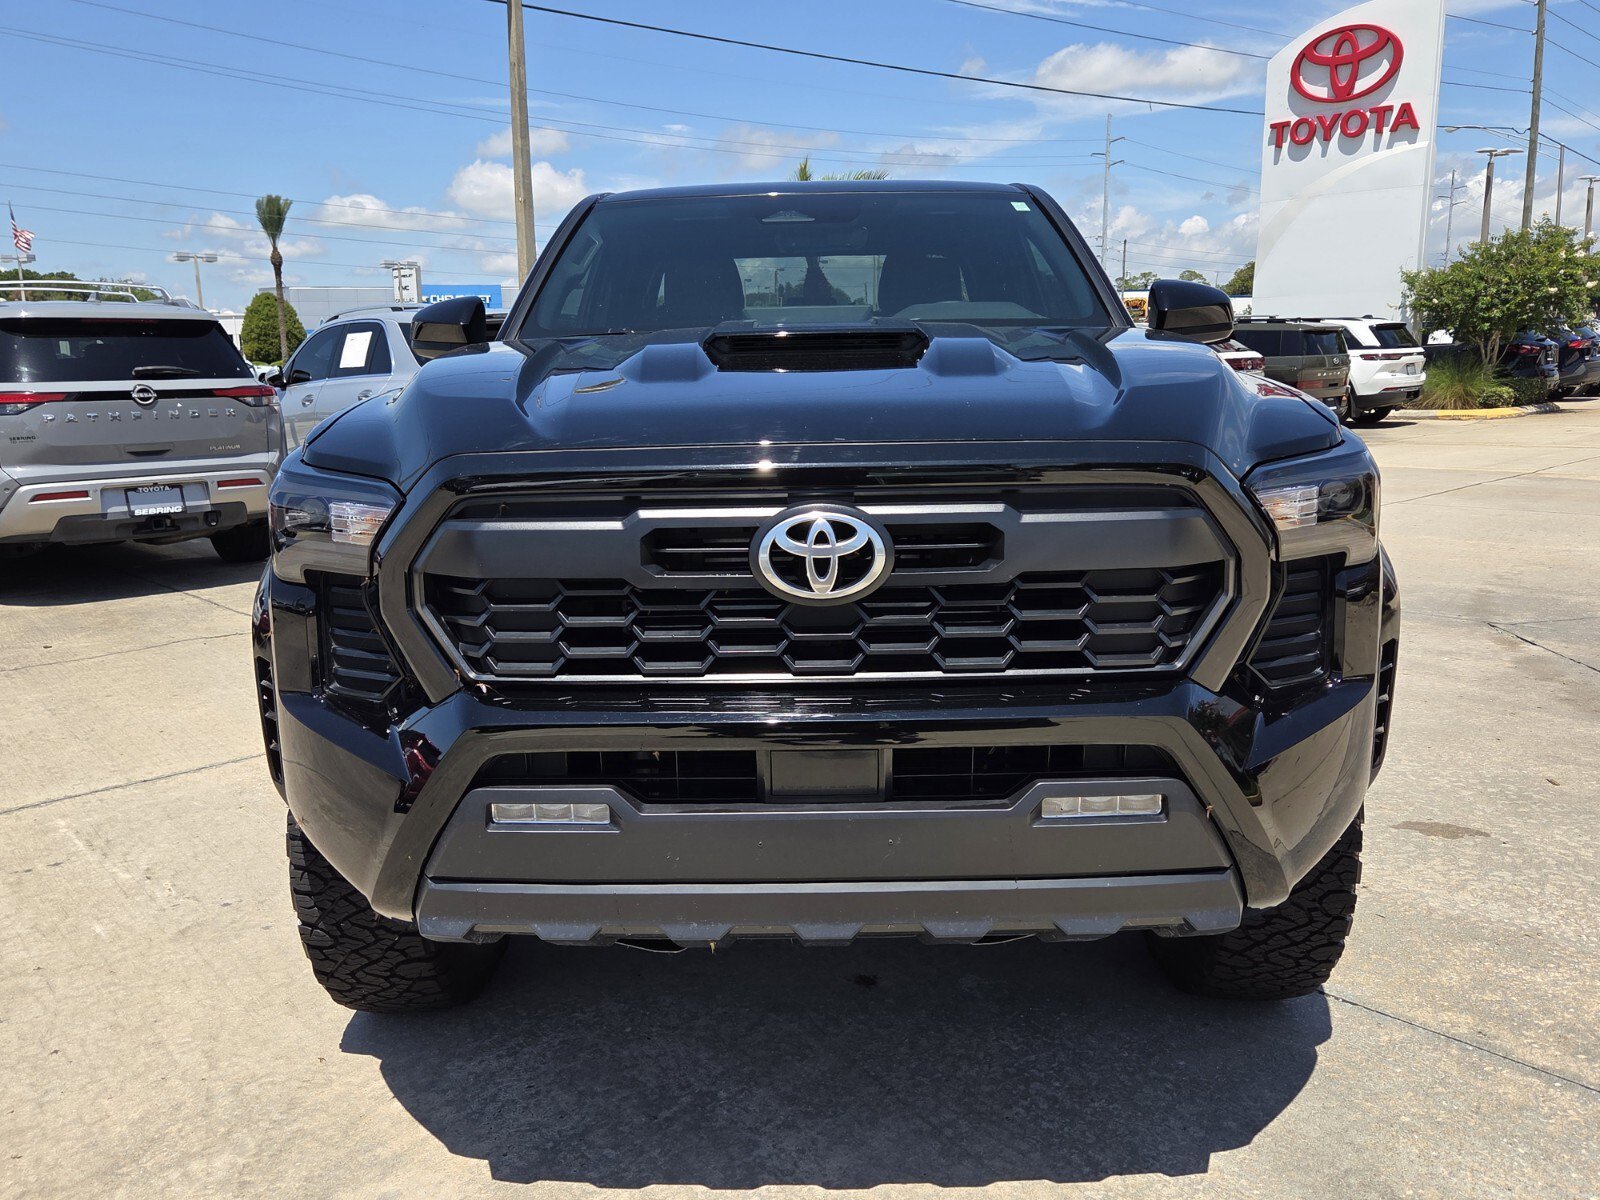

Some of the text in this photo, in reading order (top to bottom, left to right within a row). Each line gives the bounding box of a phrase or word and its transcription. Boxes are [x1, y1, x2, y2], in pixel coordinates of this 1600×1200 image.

[1270, 102, 1420, 148] TOYOTA
[42, 407, 236, 423] PATHFINDER
[137, 485, 171, 493] TOYOTA
[134, 505, 183, 516] SEBRING
